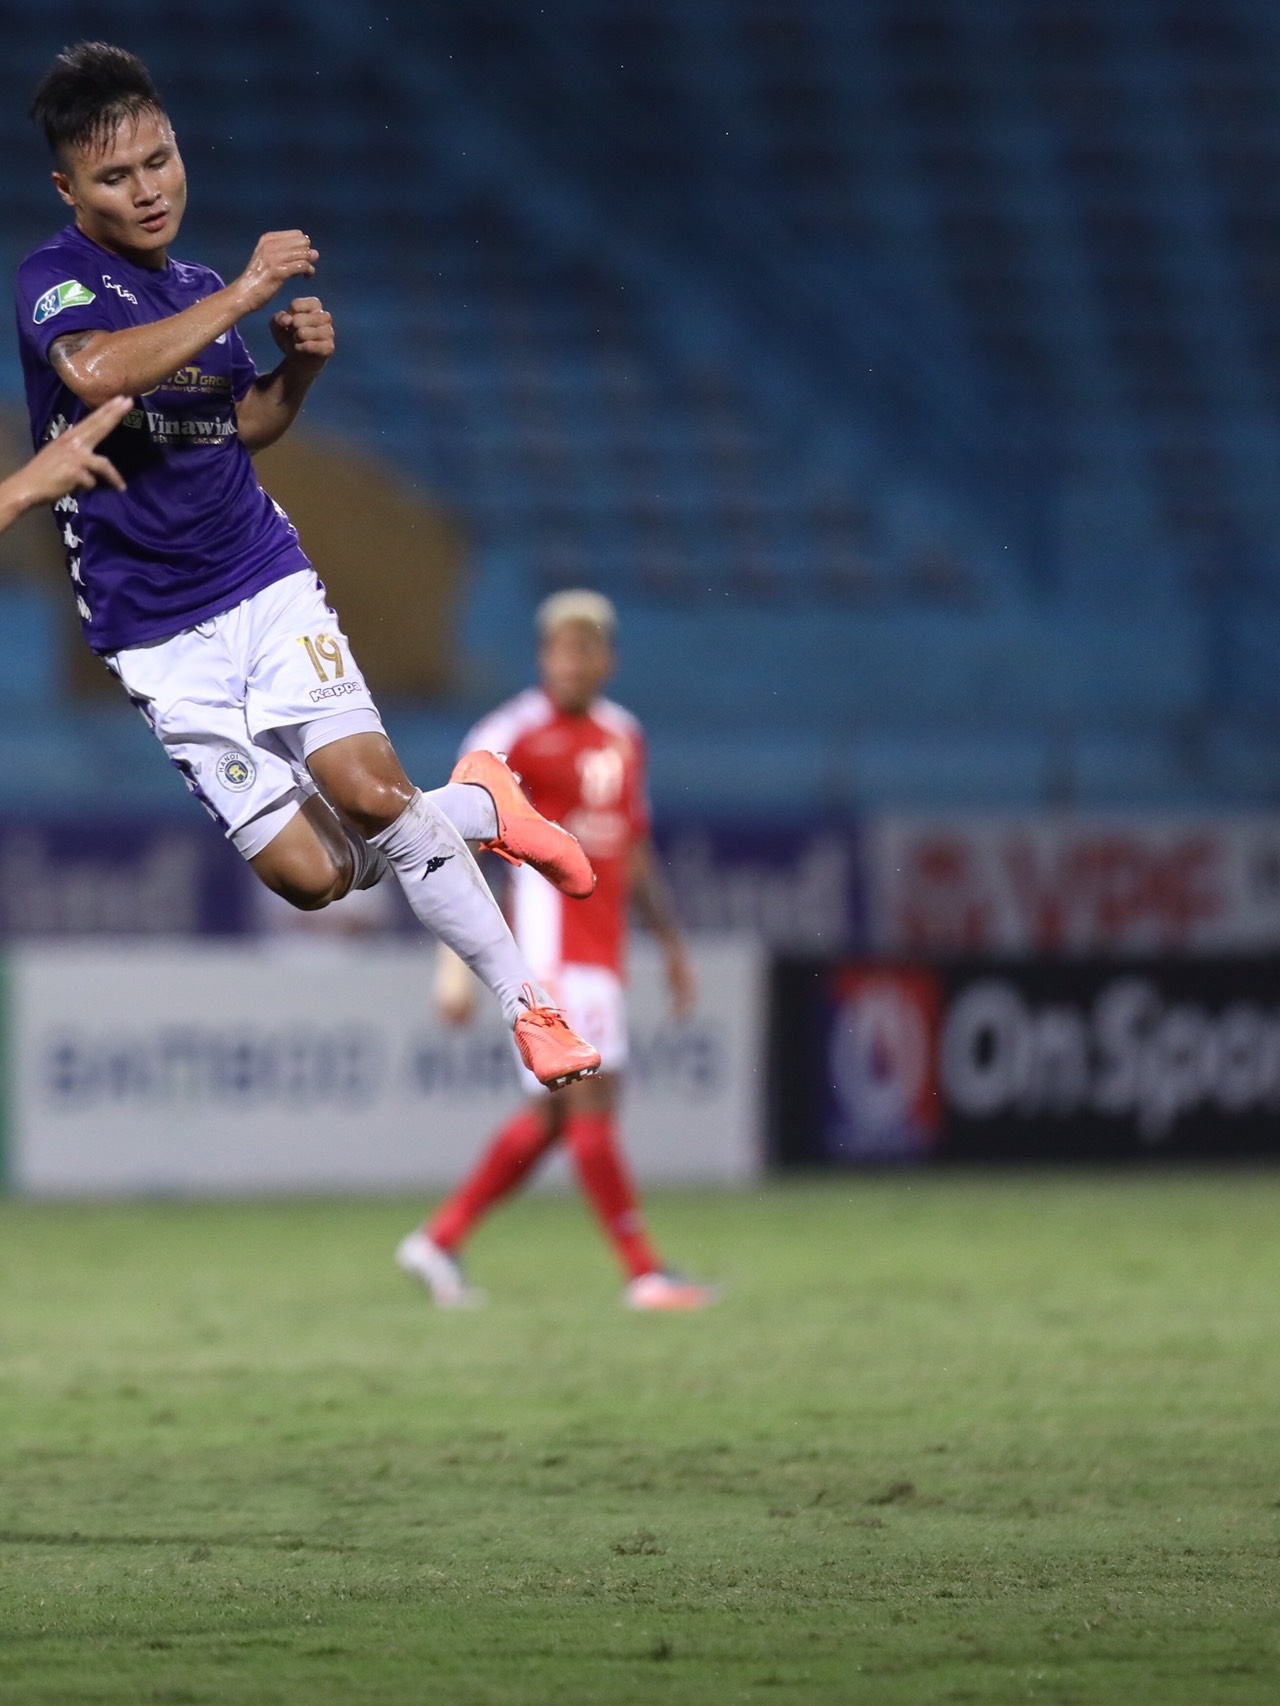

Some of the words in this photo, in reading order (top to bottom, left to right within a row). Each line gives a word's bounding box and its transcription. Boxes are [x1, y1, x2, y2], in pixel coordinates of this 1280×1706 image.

[297, 632, 345, 683] 19
[309, 682, 362, 703] Kappa
[218, 754, 239, 773] HANOI
